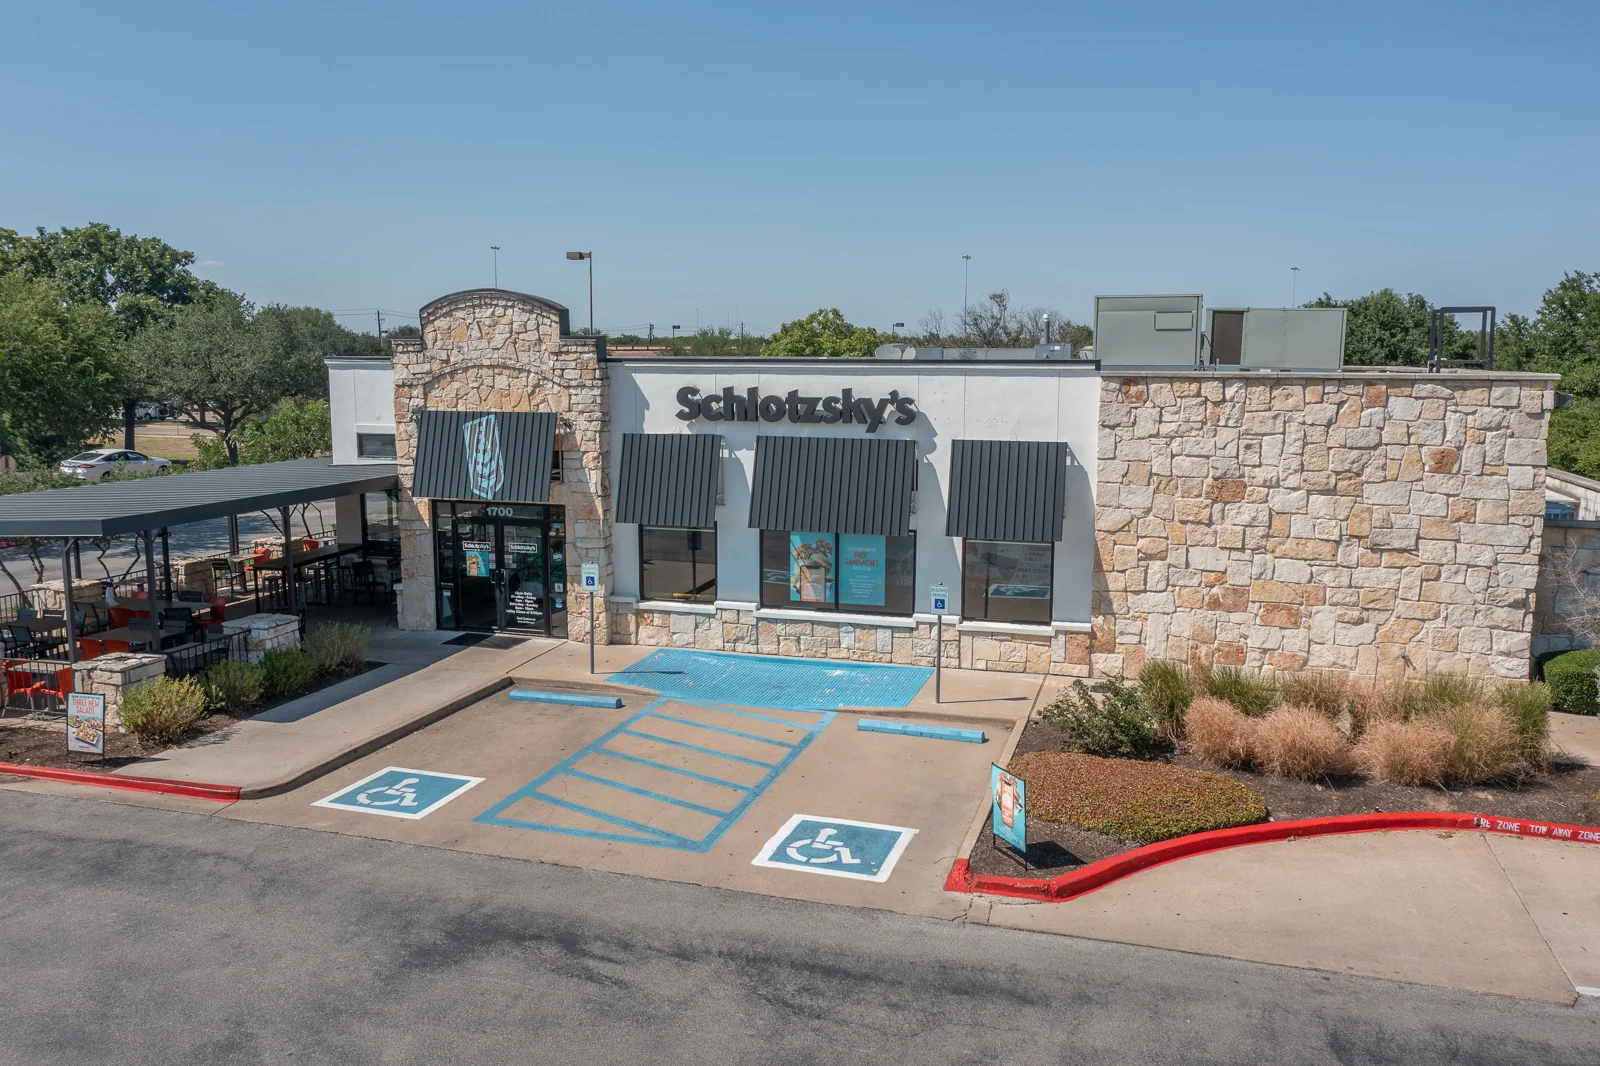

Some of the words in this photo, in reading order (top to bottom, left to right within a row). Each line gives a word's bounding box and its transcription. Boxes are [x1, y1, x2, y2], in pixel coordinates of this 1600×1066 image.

[675, 386, 917, 433] Schlotzsky's
[486, 506, 513, 516] 1700
[72, 698, 87, 706] THREE
[76, 706, 95, 714] SALADS
[1473, 817, 1491, 828] FRE
[1497, 821, 1520, 832] ZONE
[1529, 825, 1547, 834] TOW
[1552, 828, 1573, 837] AWAY
[1578, 831, 1600, 841] ZONE
